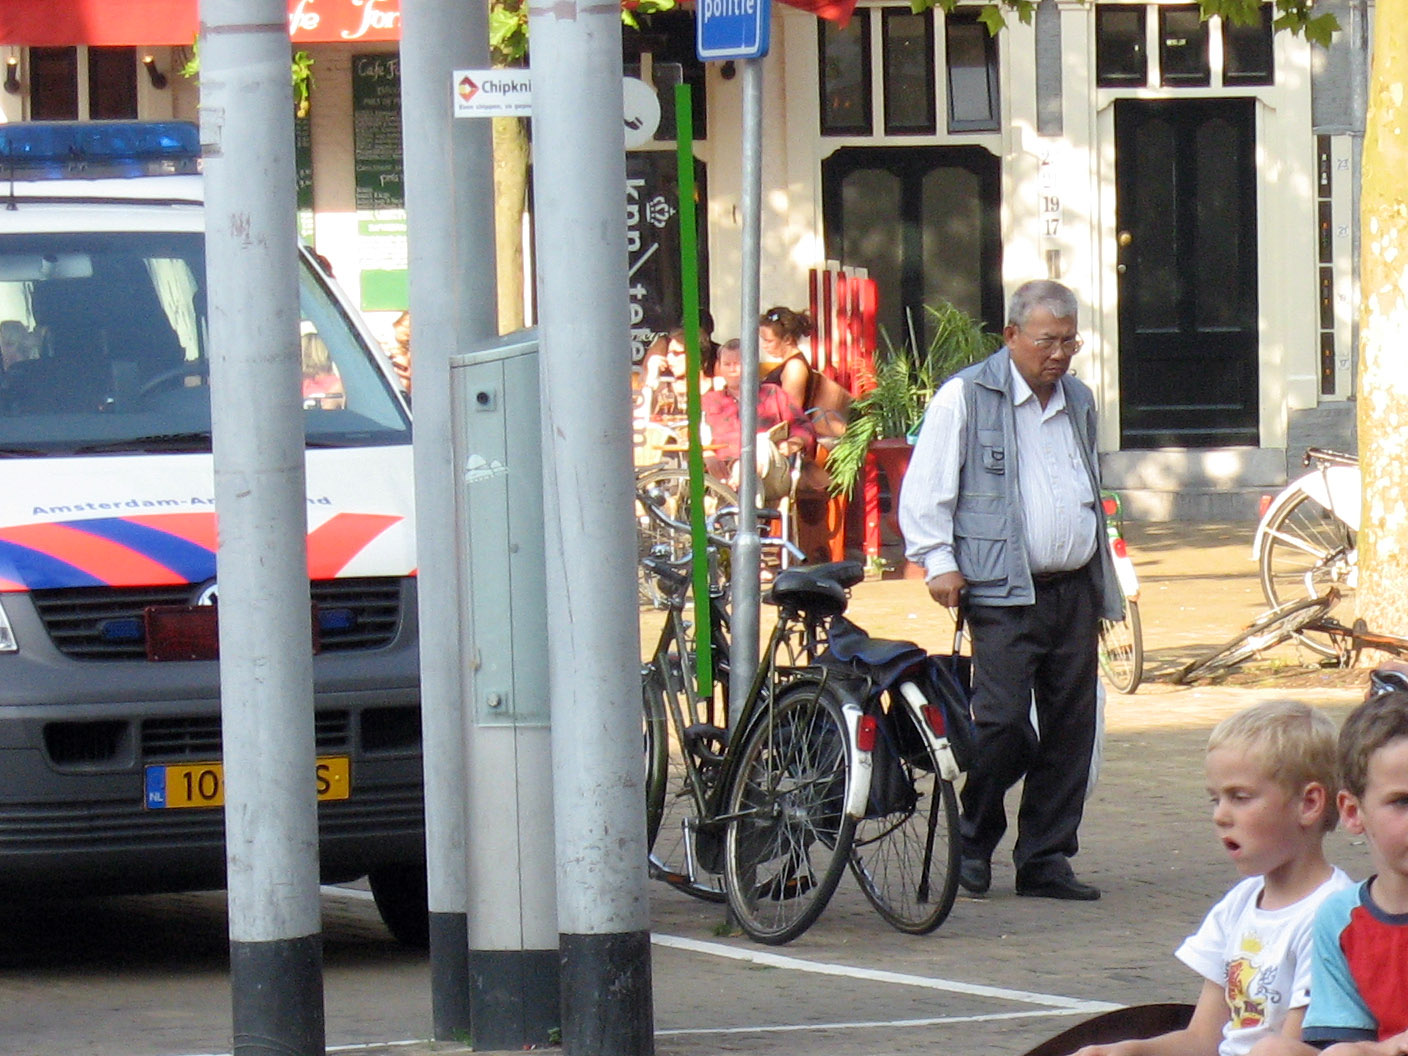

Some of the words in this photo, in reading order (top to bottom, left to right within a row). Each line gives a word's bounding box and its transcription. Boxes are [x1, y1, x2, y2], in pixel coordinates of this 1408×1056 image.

[481, 80, 531, 96] Chipkni
[1043, 195, 1060, 213] 19
[1044, 218, 1060, 236] 17
